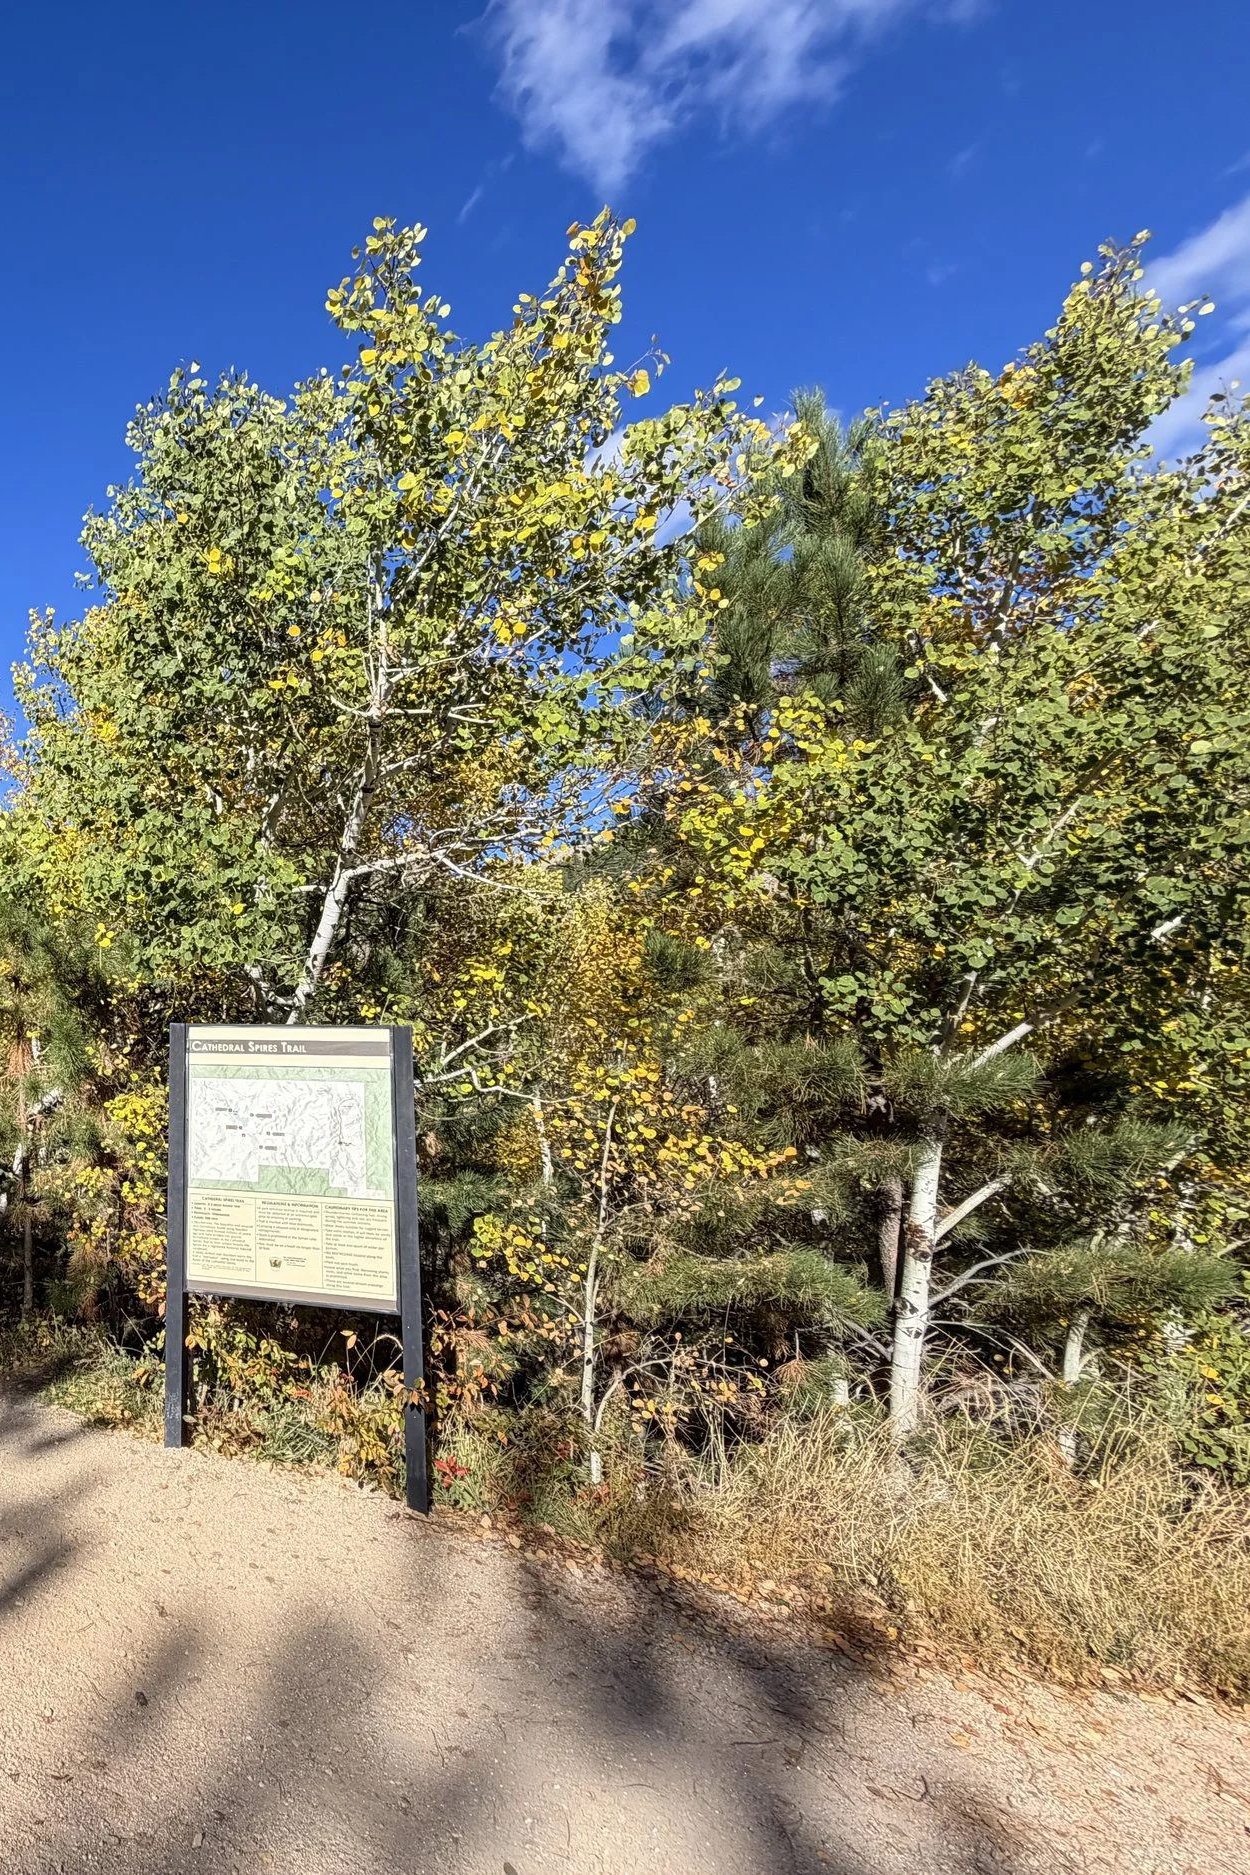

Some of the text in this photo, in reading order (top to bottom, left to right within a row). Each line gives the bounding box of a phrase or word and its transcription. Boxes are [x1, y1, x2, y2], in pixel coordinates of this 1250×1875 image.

[191, 1041, 307, 1053] CATHEDRAL SPIRES TRAIL
